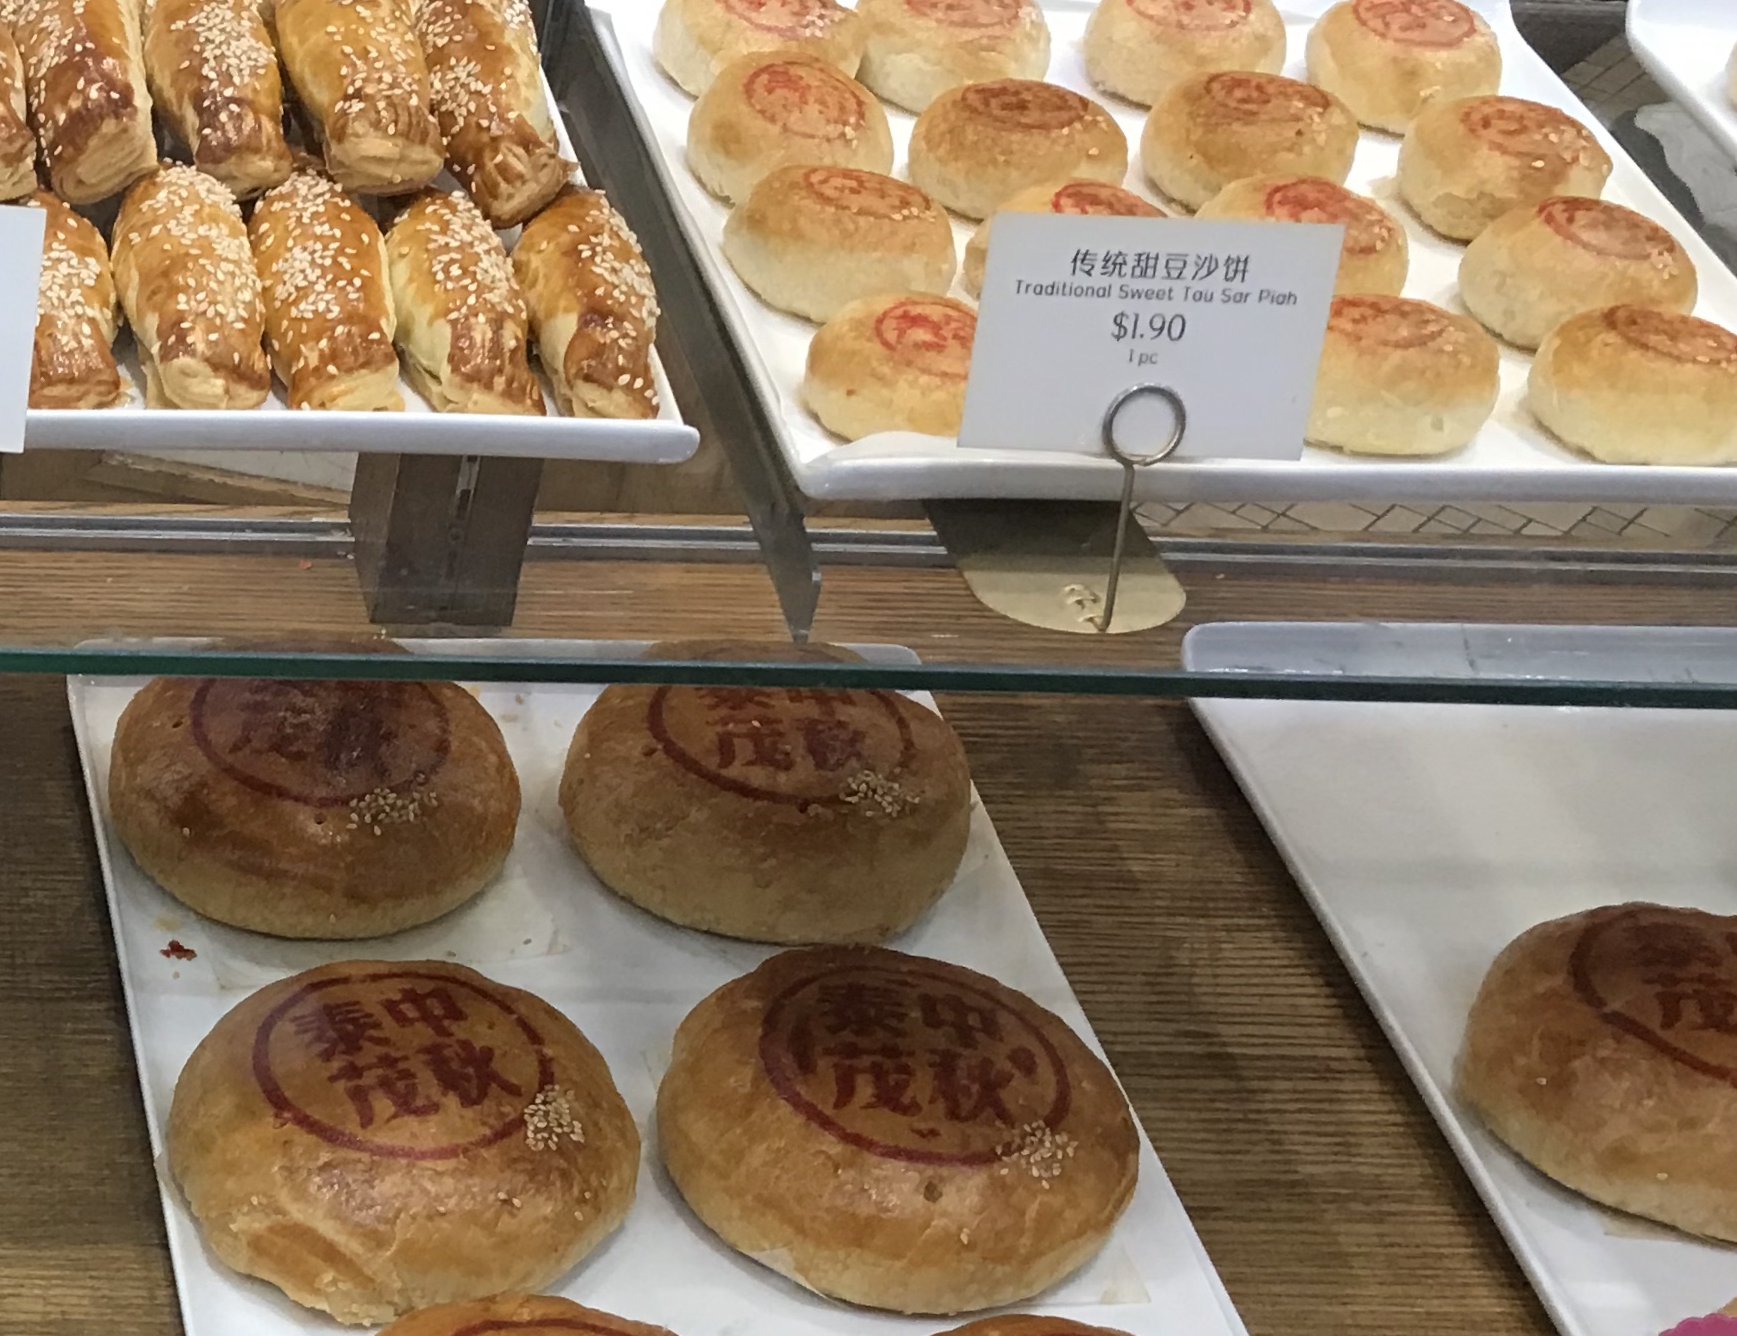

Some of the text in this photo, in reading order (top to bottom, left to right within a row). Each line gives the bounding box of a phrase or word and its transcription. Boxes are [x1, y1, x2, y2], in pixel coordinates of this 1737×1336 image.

[1070, 249, 1250, 284] 传统甜豆沙饼
[1015, 280, 1298, 305] Traditional Sweet Tau Sar Piah
[1112, 311, 1187, 342] $1.90
